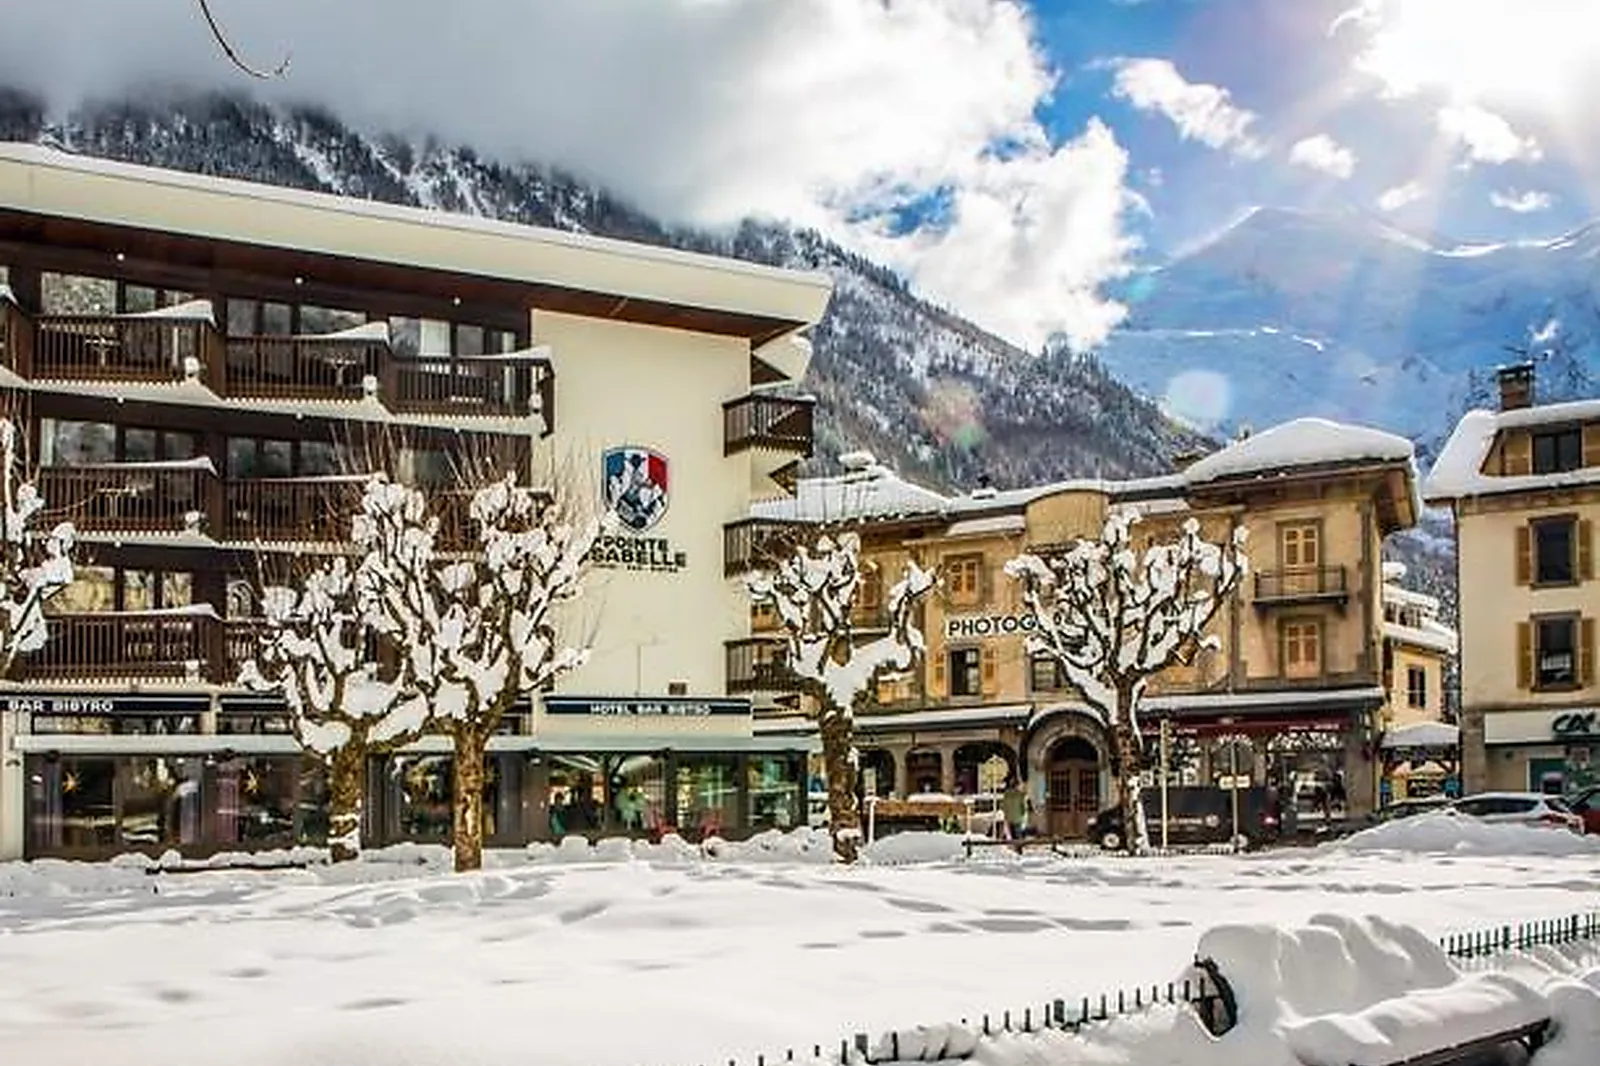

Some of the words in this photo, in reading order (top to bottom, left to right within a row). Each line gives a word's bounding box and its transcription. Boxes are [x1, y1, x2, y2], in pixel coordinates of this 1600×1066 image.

[587, 547, 686, 568] SABELLE
[948, 613, 1038, 637] PHOTOG
[8, 699, 43, 713] BAR
